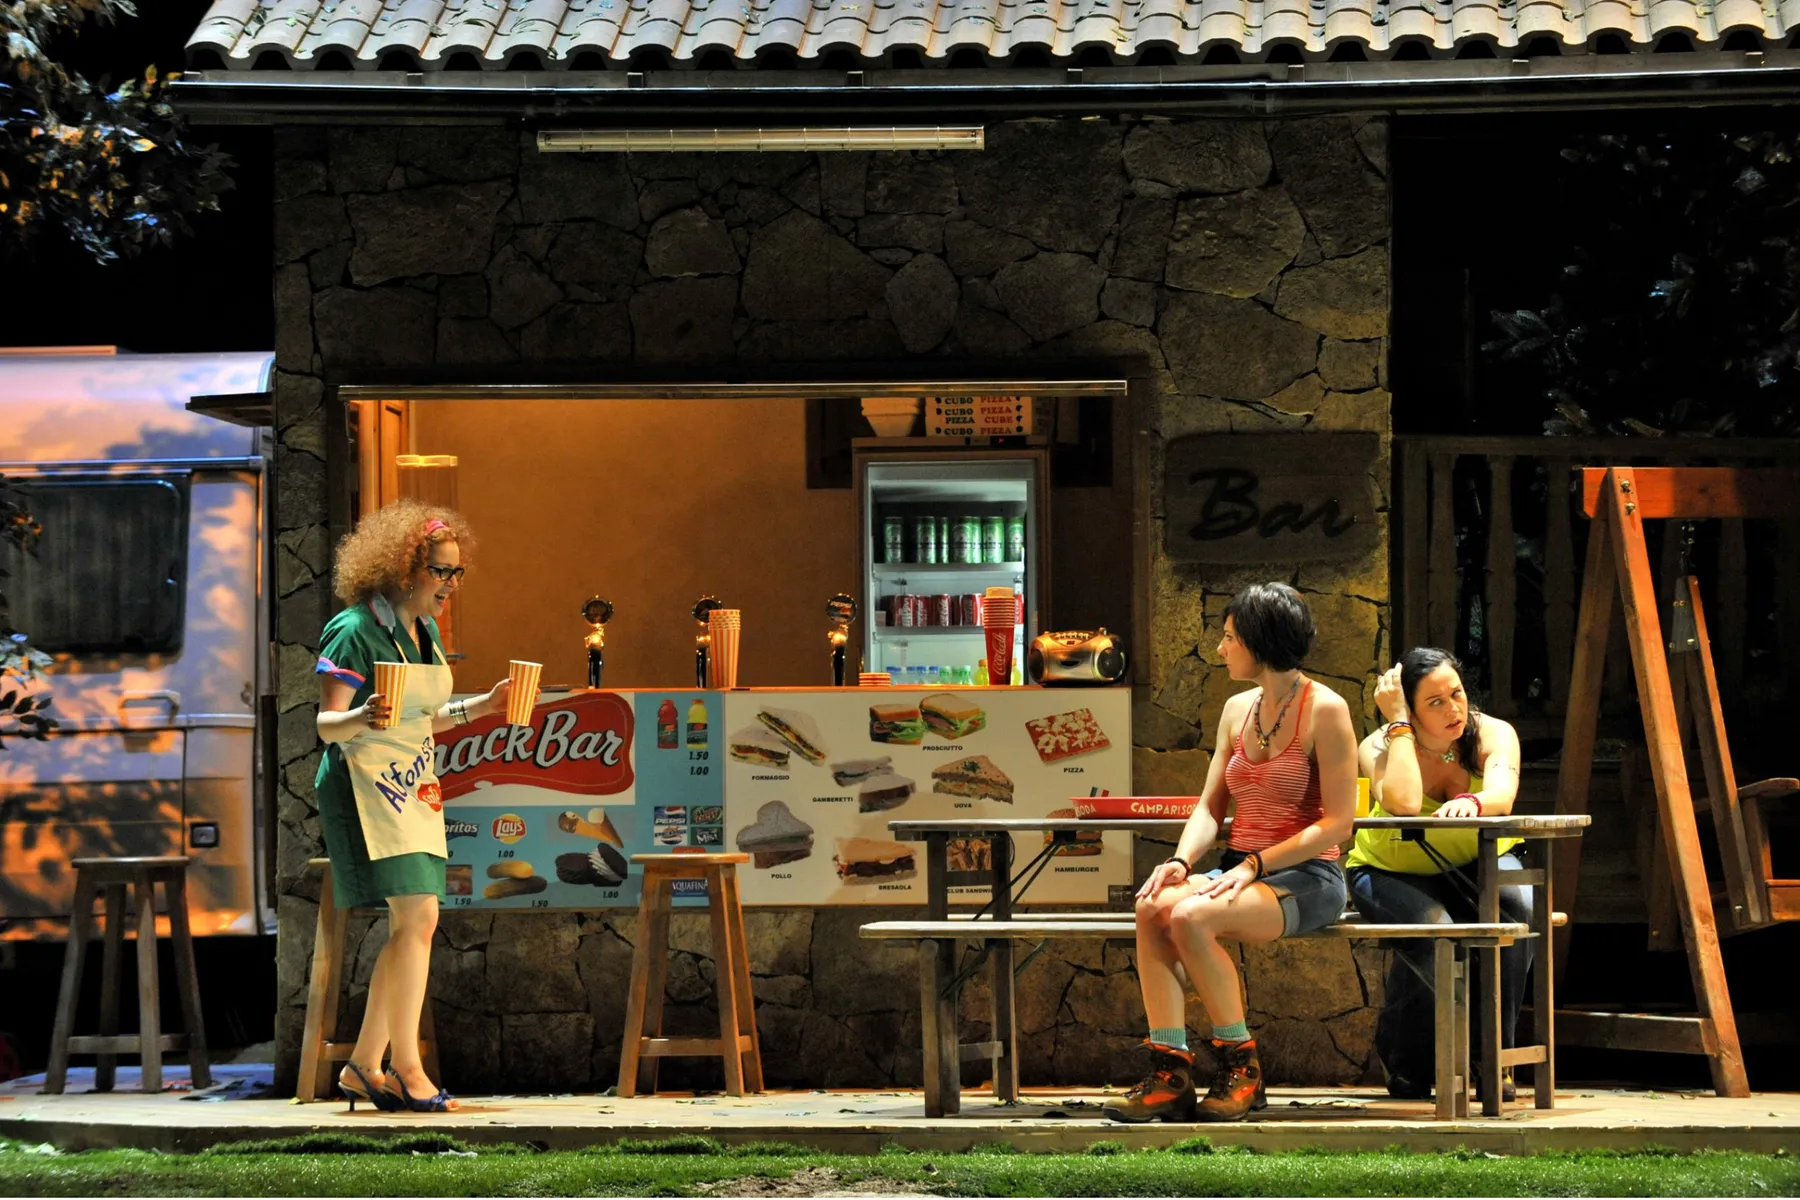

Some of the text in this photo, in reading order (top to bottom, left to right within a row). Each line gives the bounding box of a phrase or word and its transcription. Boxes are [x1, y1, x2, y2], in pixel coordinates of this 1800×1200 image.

[944, 397, 974, 405] CUBO
[944, 408, 974, 416] CUBO
[945, 416, 975, 424] PIZZA
[944, 427, 1012, 435] CUBO PIZZA
[1187, 468, 1357, 541] Bar
[434, 709, 623, 778] nack Bar
[688, 751, 709, 760] 1.50
[689, 766, 709, 775] 1.00
[445, 821, 478, 833] oritos
[498, 850, 514, 858] 1.00
[603, 891, 619, 899] 1.00
[455, 897, 471, 906] 1.50
[532, 900, 548, 908] 1.50
